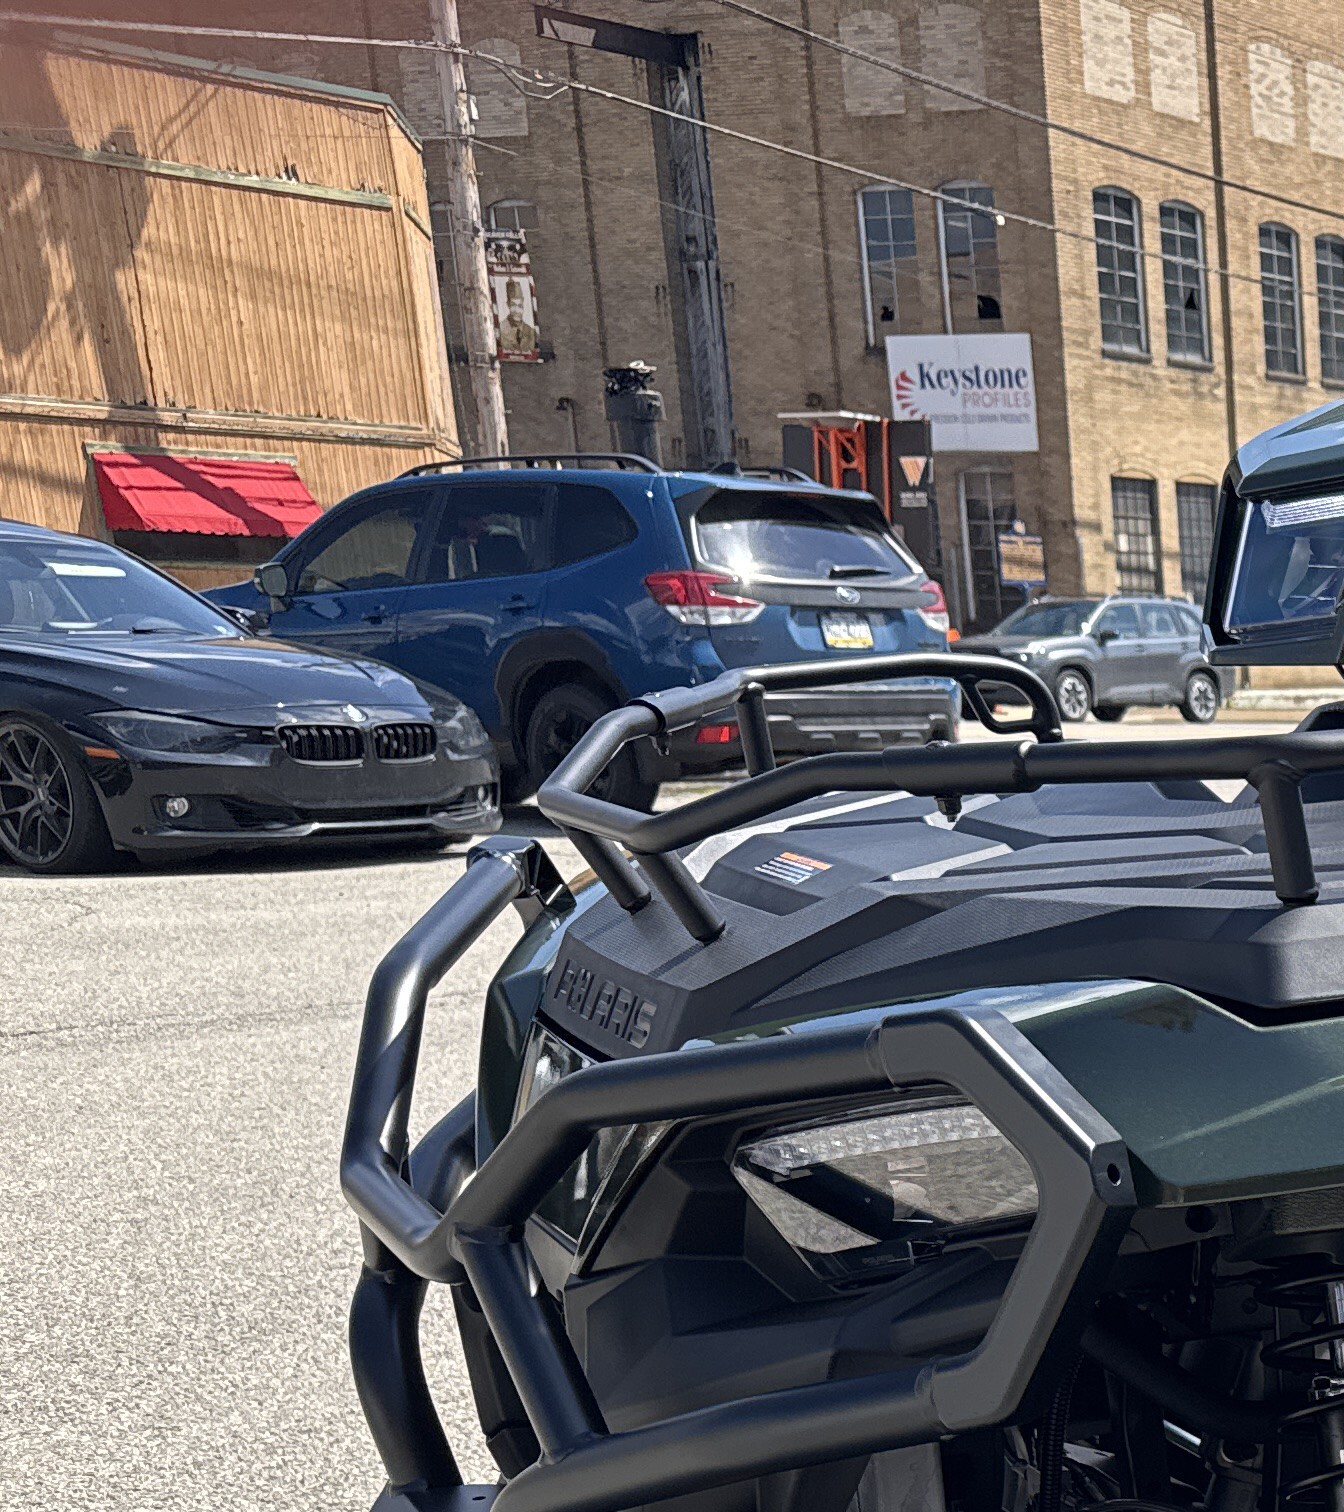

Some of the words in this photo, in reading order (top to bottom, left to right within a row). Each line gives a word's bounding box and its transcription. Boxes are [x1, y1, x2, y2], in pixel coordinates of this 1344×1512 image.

[918, 362, 1029, 396] Keystone
[961, 391, 1031, 409] PROFILES
[553, 958, 658, 1049] POLARIS
